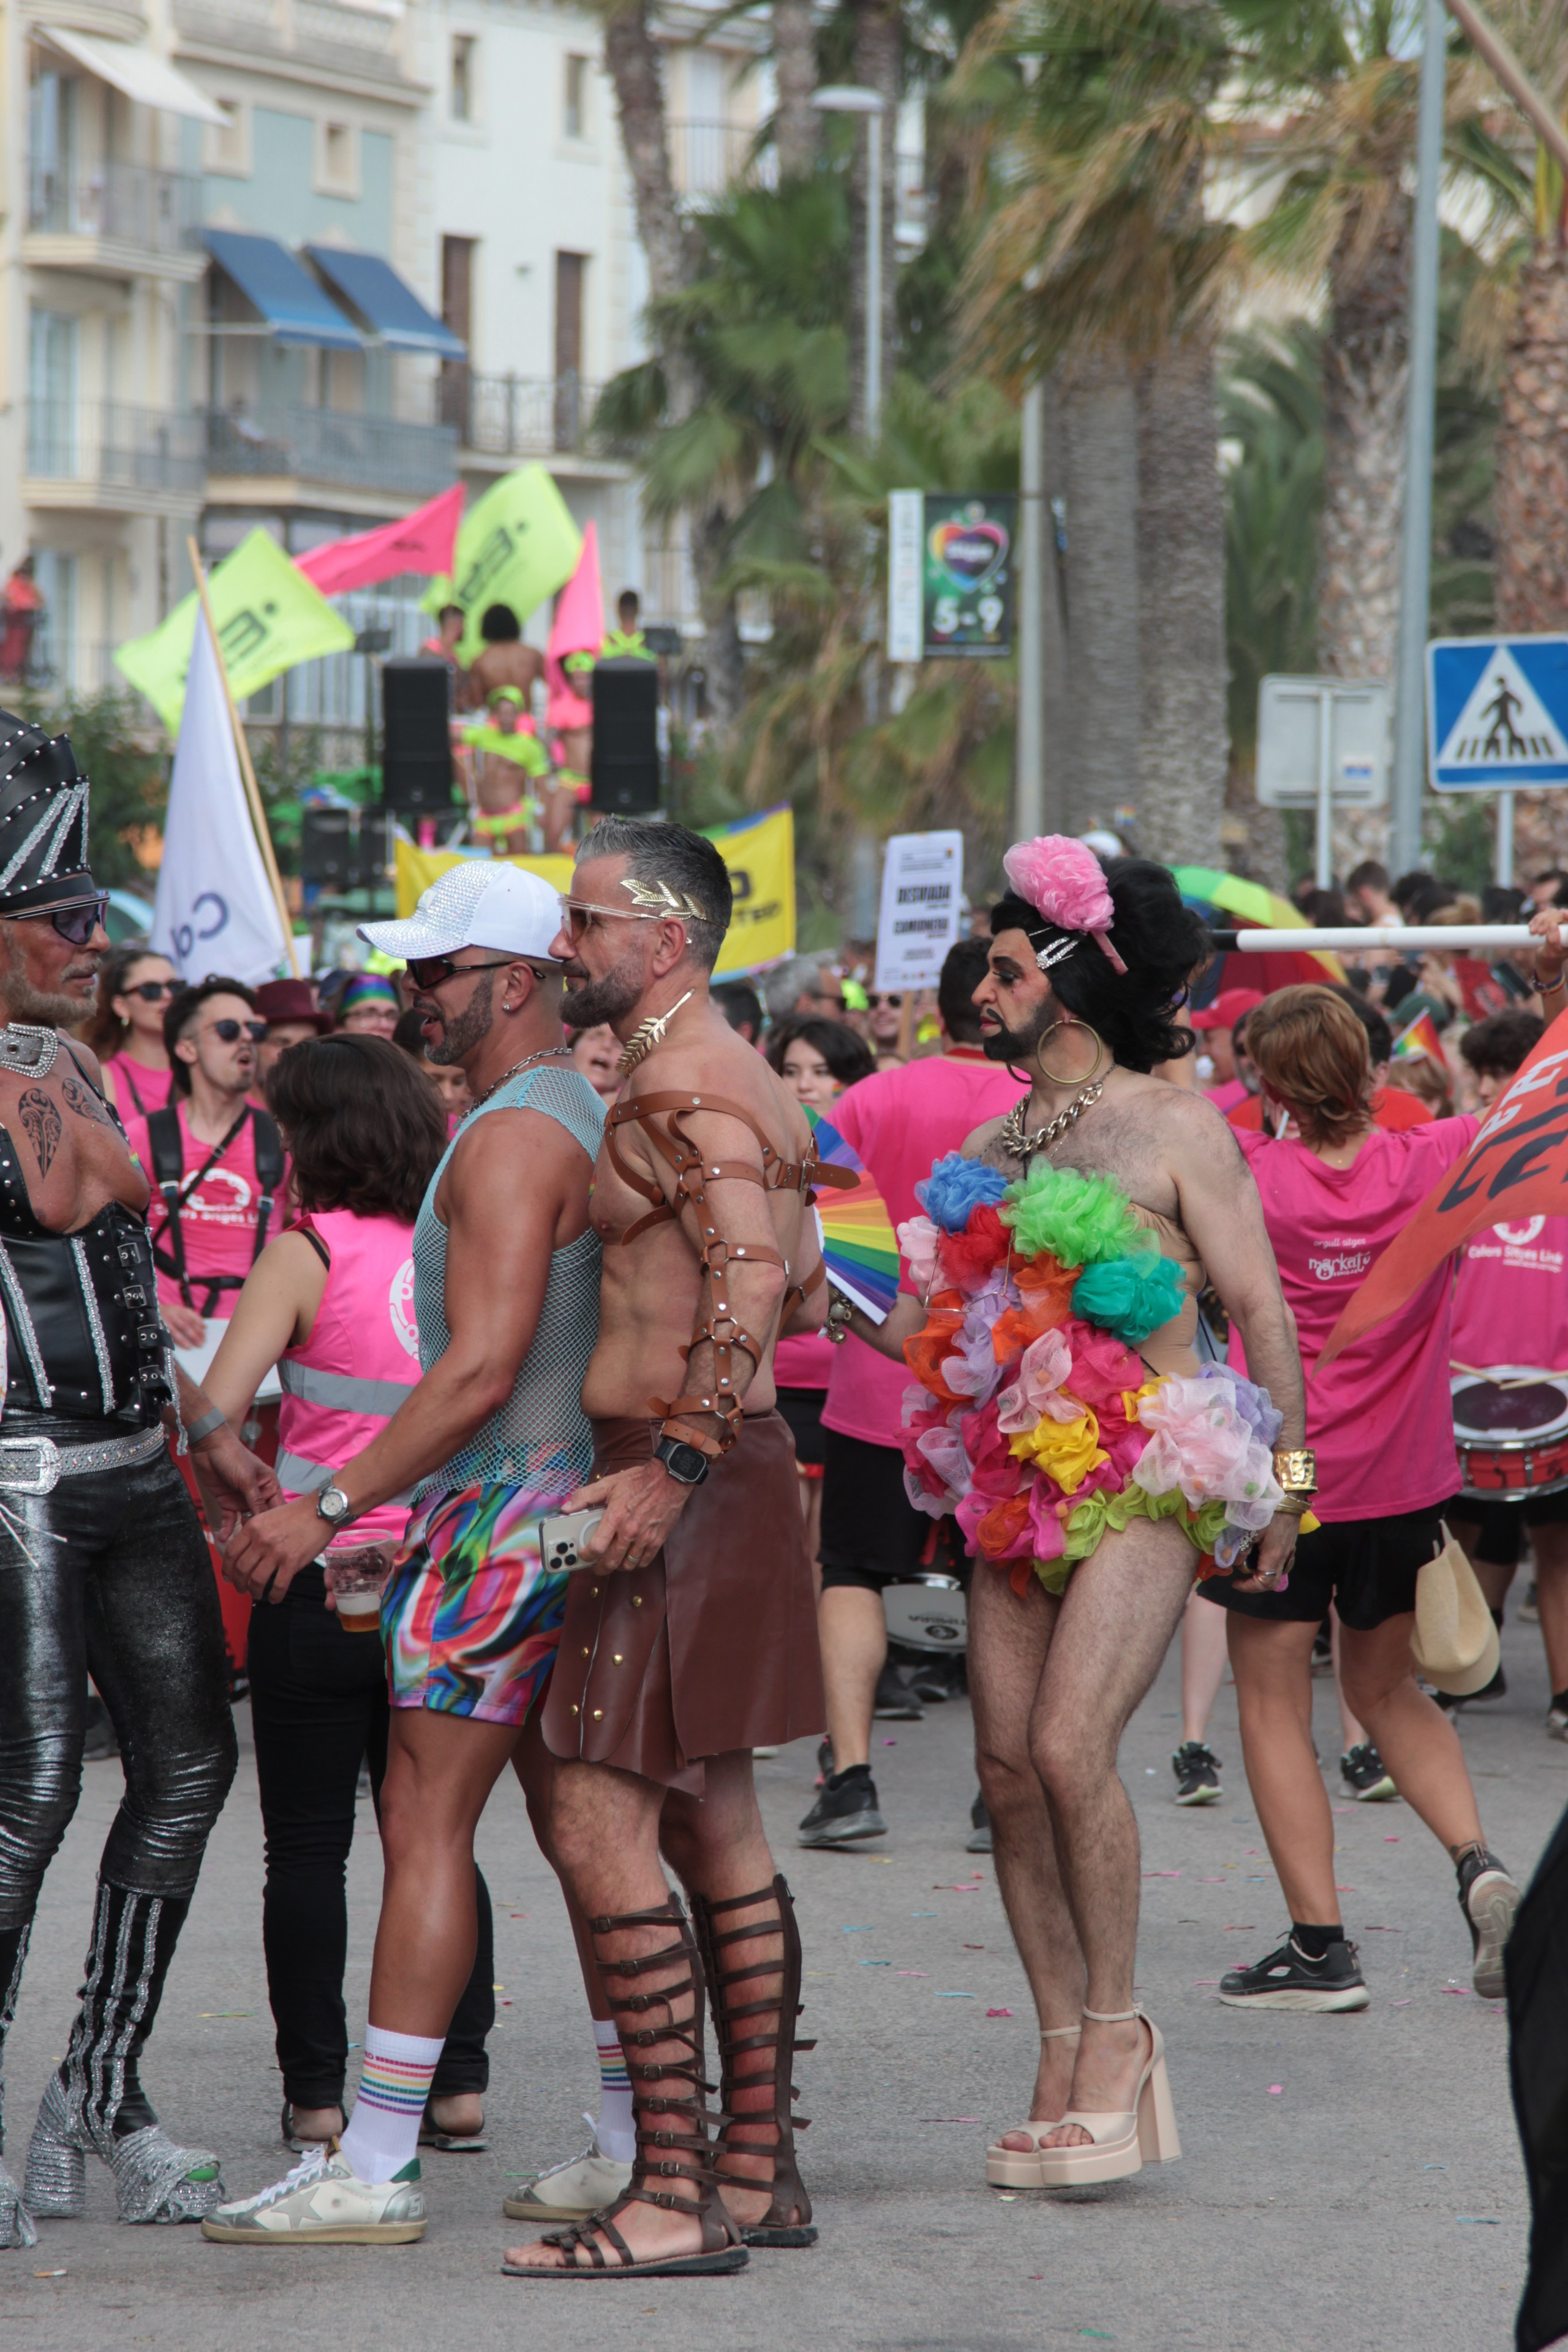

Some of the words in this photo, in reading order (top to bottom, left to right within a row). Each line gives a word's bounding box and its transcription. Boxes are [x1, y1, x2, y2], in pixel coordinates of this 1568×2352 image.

[933, 595, 1004, 633] 5-9
[898, 885, 950, 903] DESVIADA
[1313, 1237, 1340, 1250] orgull
[1342, 1238, 1366, 1248] sitges
[1468, 1243, 1502, 1259] Colors
[1504, 1245, 1537, 1261] Sitges
[1539, 1248, 1563, 1265] Link
